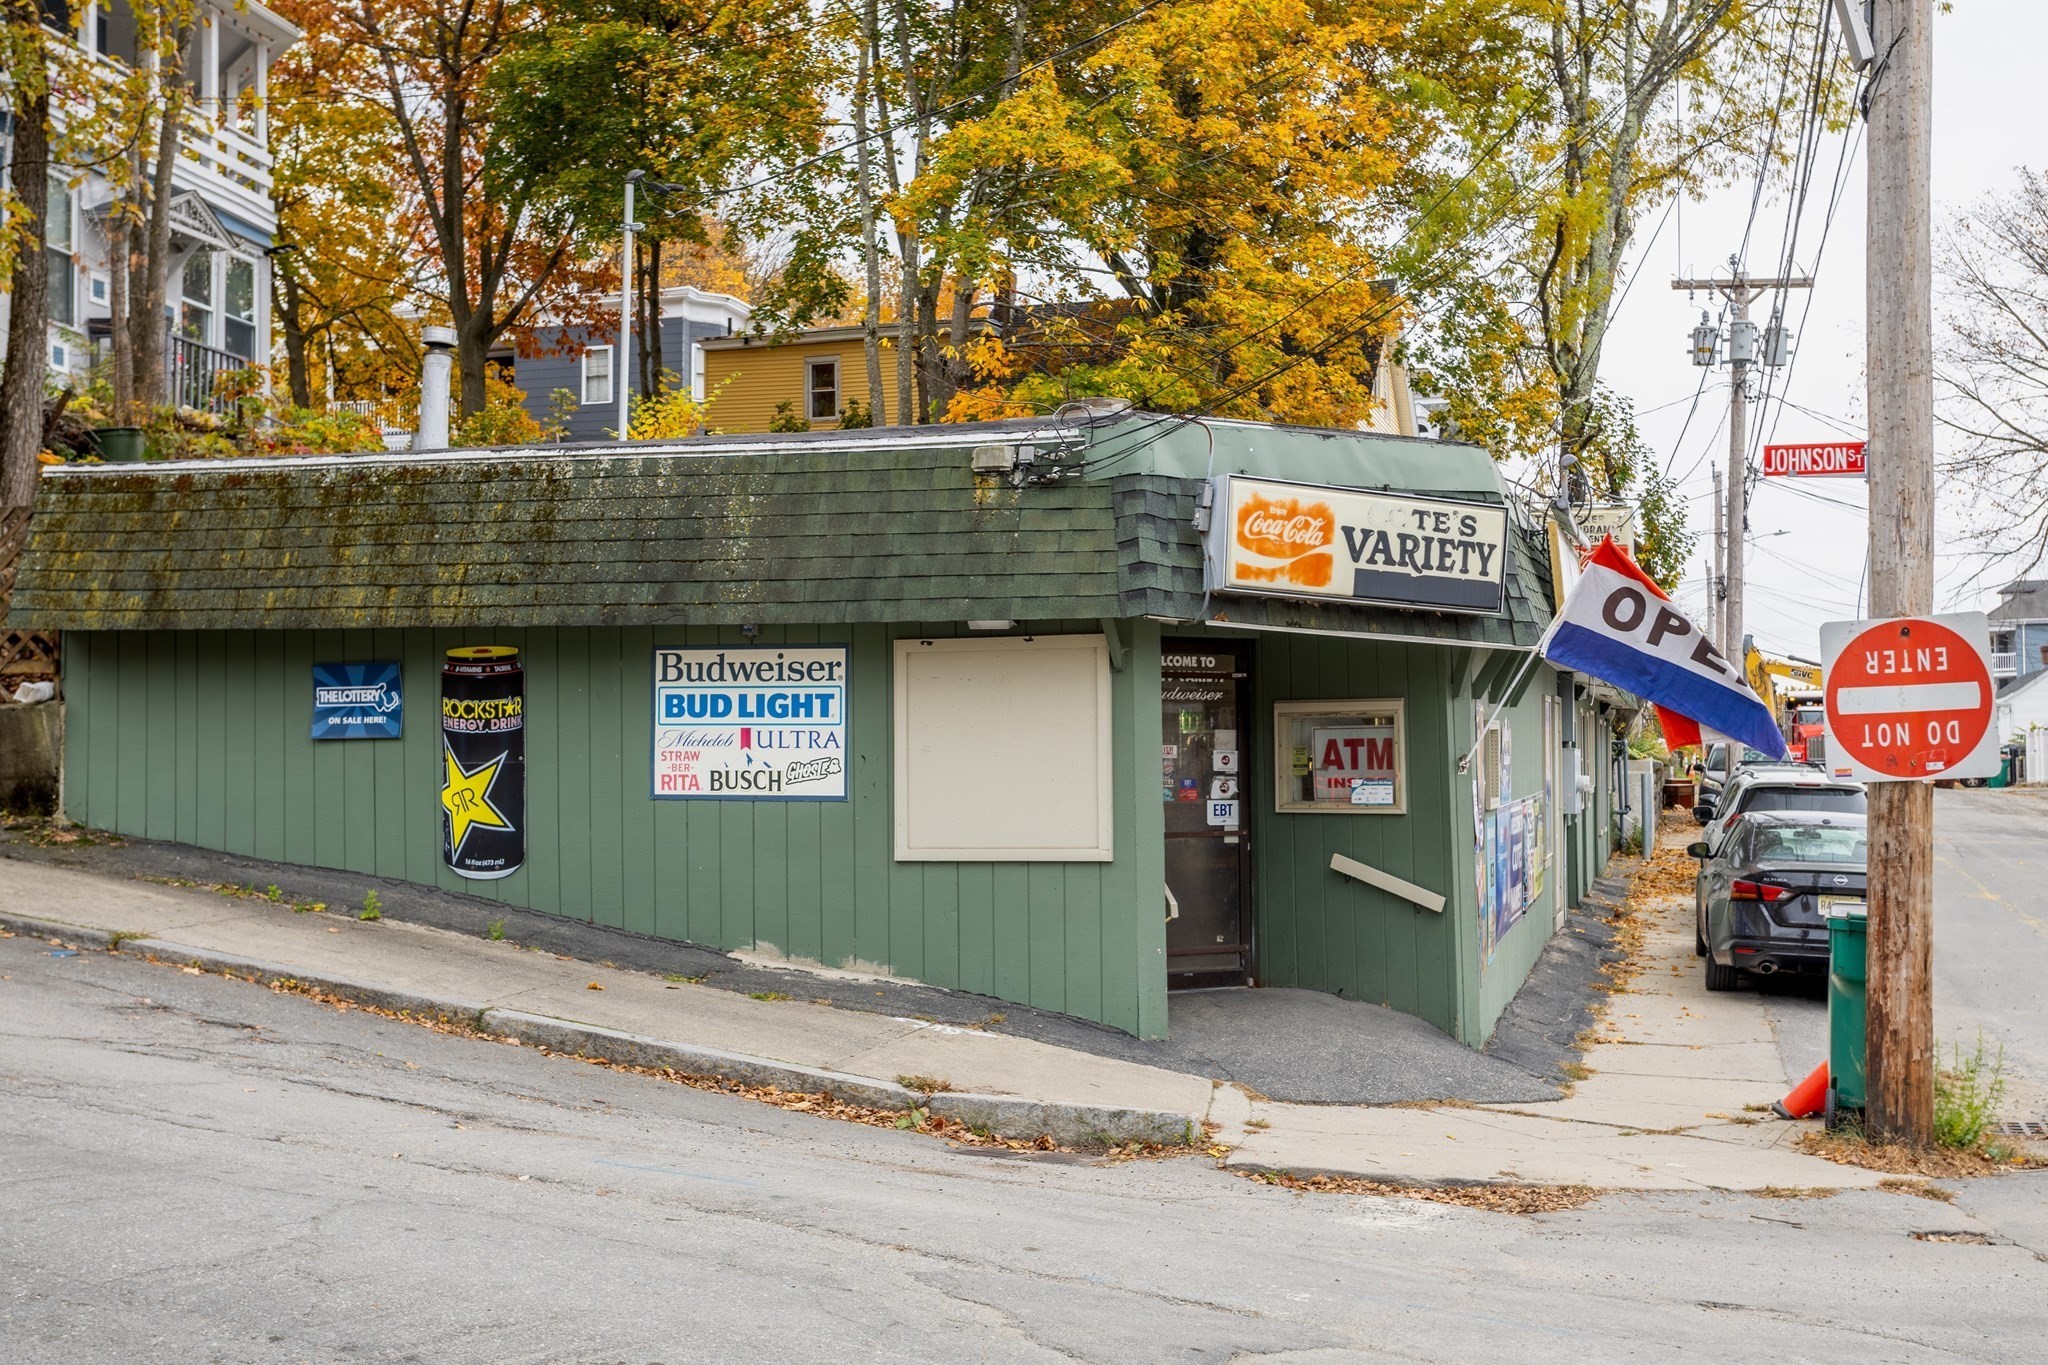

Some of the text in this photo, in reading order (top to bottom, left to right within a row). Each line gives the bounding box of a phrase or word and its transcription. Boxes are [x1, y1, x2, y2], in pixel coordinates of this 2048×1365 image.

[1765, 447, 1863, 473] JOHNSON ST
[1270, 506, 1288, 516] Enjoy
[1341, 526, 1497, 577] VARIETY
[1602, 586, 1749, 688] OPE
[658, 652, 842, 682] Budweiser
[1161, 655, 1216, 668] LCOME TO
[1865, 647, 1948, 674] ENTER
[1161, 686, 1224, 700] udweiser
[664, 692, 835, 719] BUD LIGHT
[328, 716, 387, 725] ON SALE HERE!
[443, 714, 522, 731] ENERGY DRINK
[657, 729, 841, 749] Michelob ULTRA
[1862, 720, 1960, 748] DO NOT
[661, 751, 701, 762] STRAW
[1321, 738, 1393, 770] ATM
[710, 770, 782, 792] BUSCH
[786, 756, 831, 785] GHOST
[661, 774, 700, 791] RITA
[1213, 803, 1233, 817] EBT
